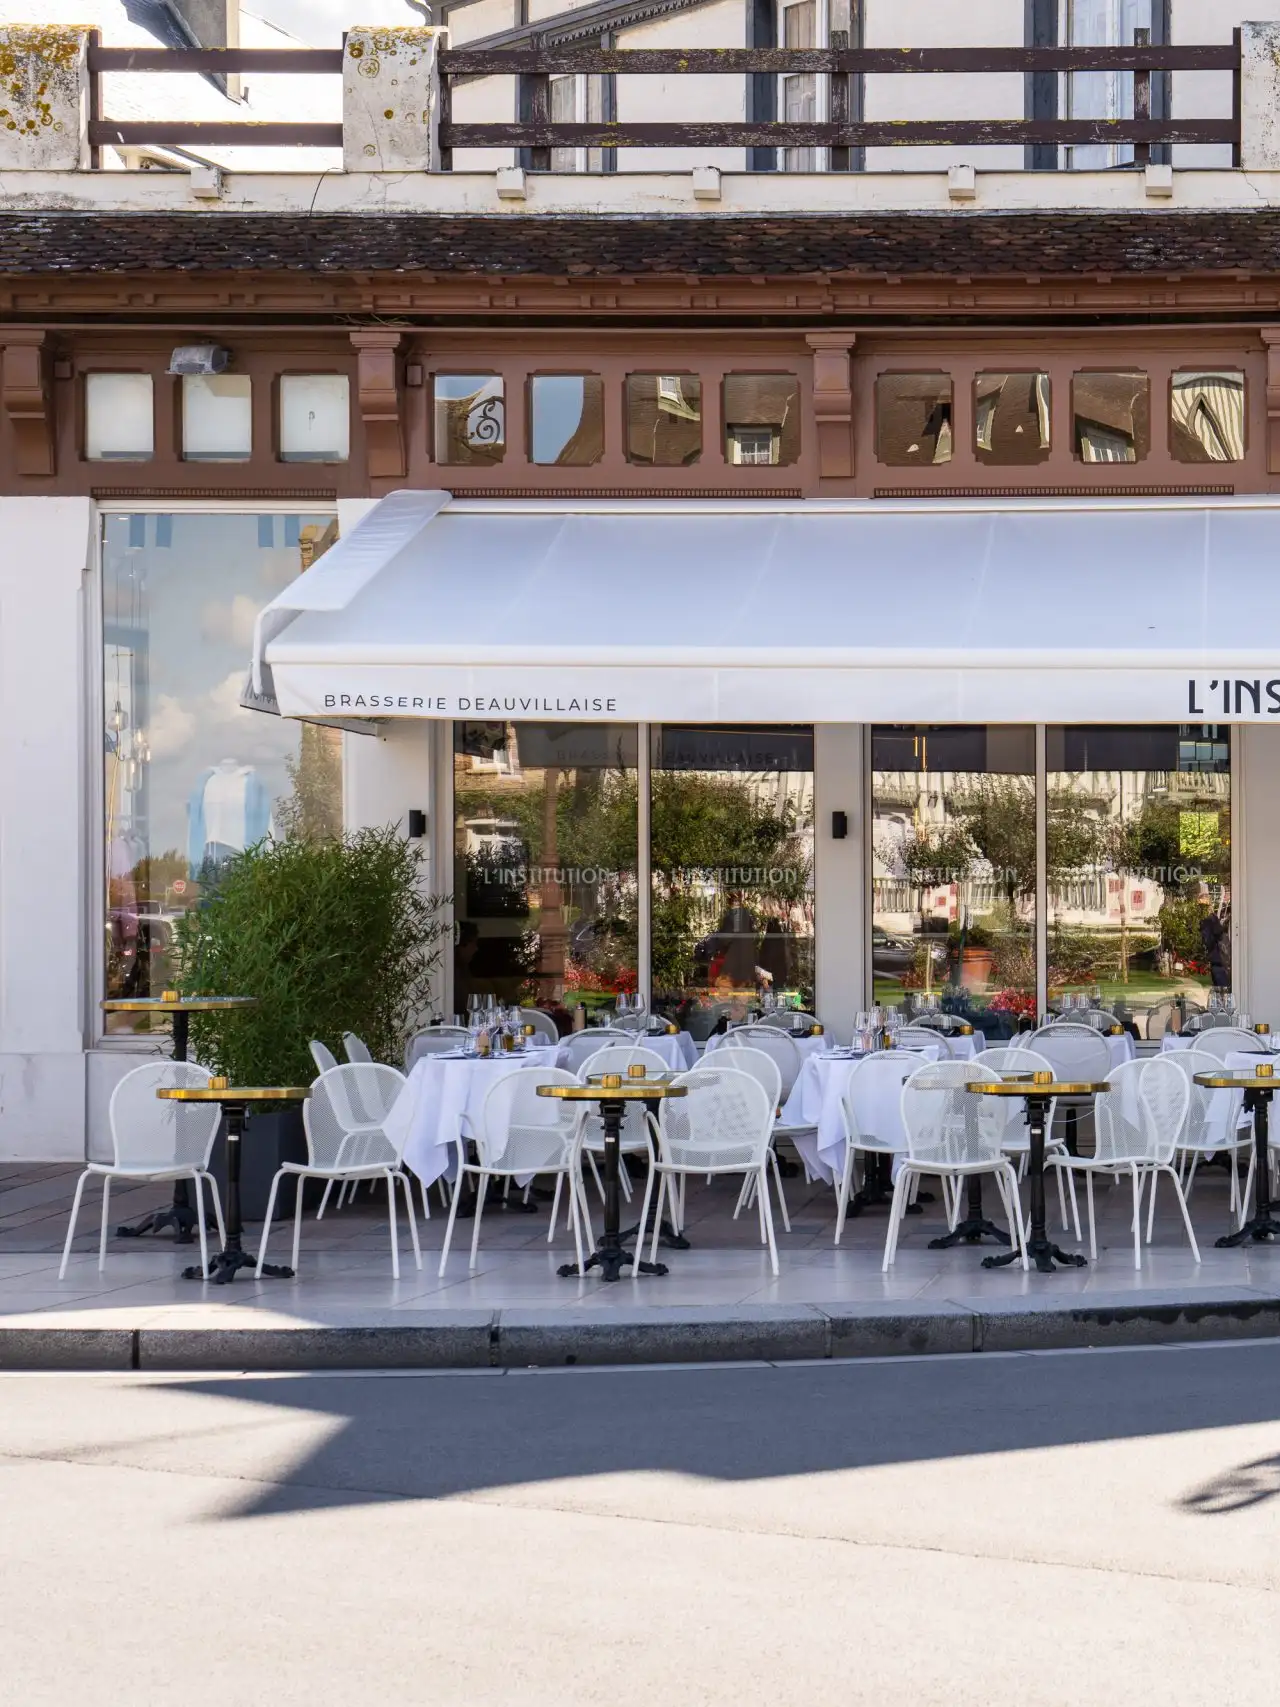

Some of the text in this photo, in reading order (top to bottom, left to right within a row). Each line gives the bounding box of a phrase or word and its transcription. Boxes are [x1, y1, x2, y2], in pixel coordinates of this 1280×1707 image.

[324, 694, 617, 712] BRASSERIE DEAUVILLAISE
[484, 867, 611, 885] L'INSTITUTION
